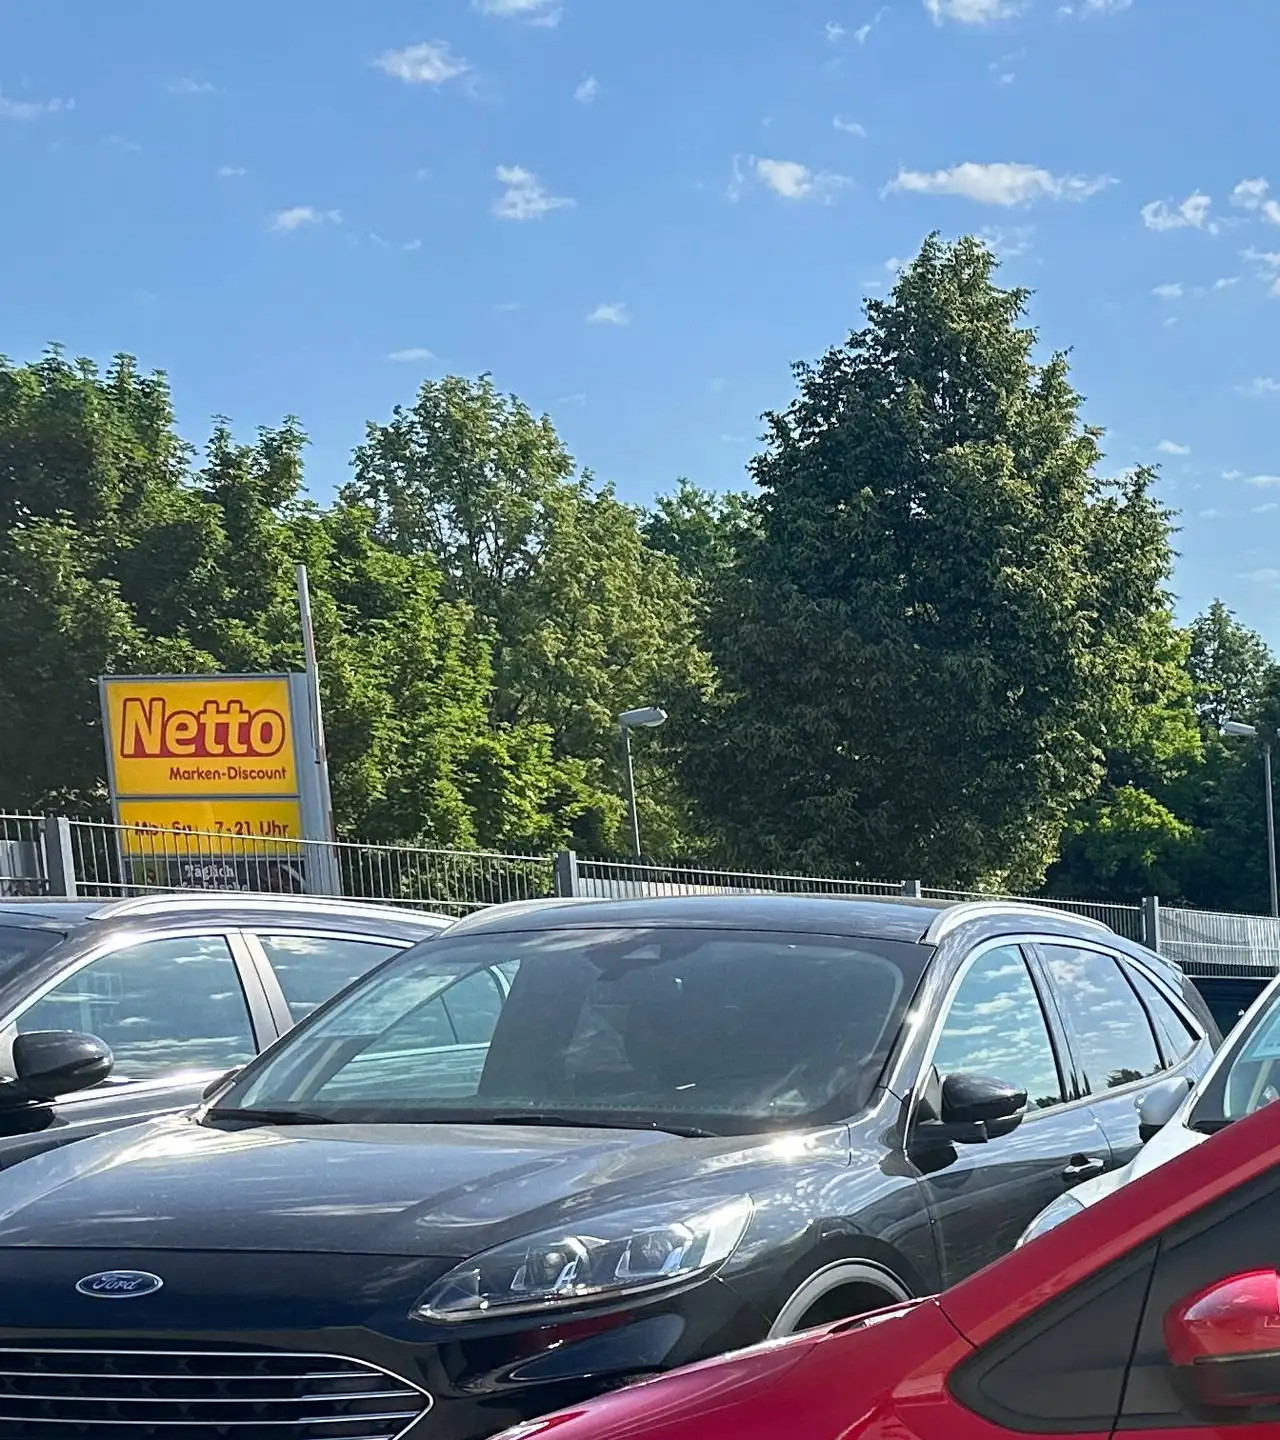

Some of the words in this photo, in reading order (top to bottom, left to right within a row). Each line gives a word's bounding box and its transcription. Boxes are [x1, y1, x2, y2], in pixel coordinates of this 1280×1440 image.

[121, 697, 286, 758] Netto
[169, 766, 287, 781] Marken-Discount
[92, 1274, 142, 1290] Ford
